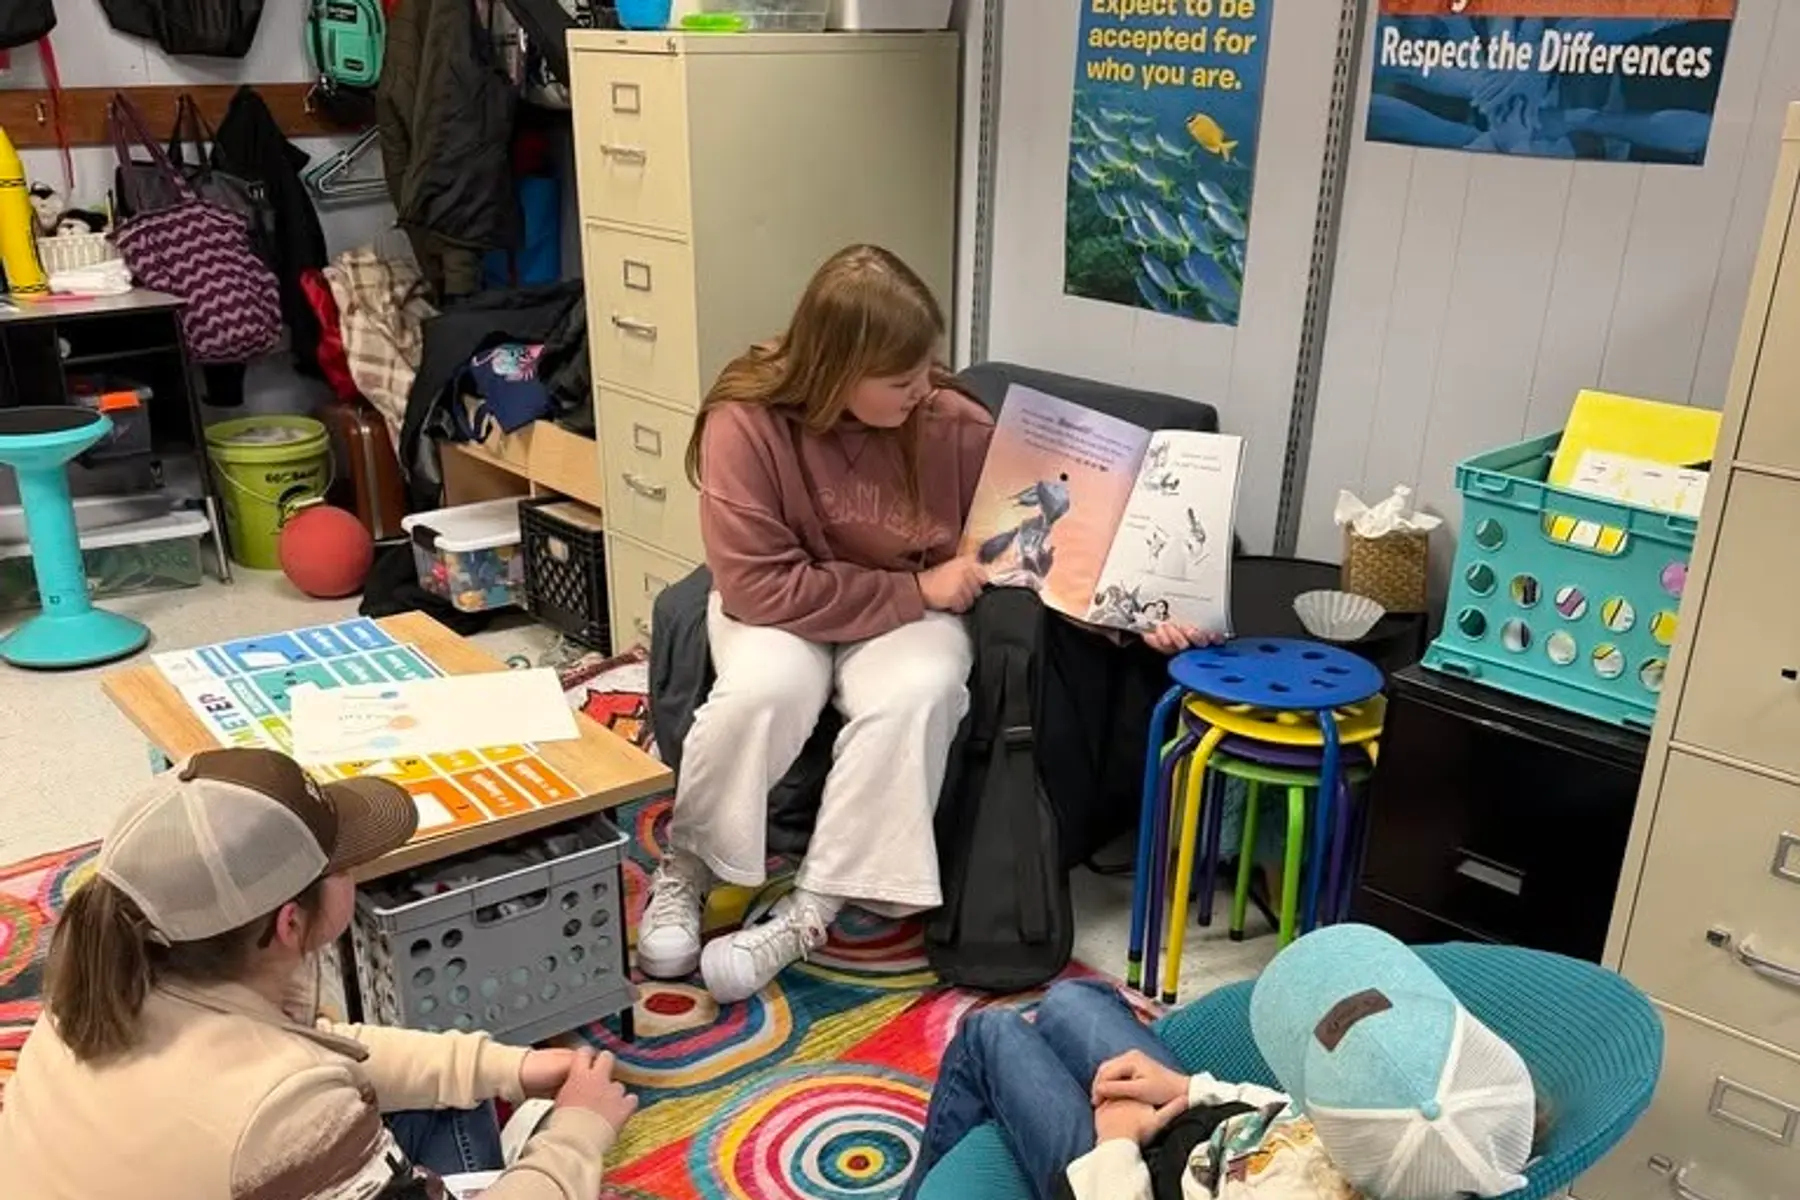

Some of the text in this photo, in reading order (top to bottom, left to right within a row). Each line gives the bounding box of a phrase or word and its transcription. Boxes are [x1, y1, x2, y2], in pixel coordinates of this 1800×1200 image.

[1091, 0, 1255, 21] Expect to be
[1088, 27, 1257, 56] accepted for
[1381, 26, 1713, 78] Respect the Differences
[1086, 57, 1243, 90] who you are.
